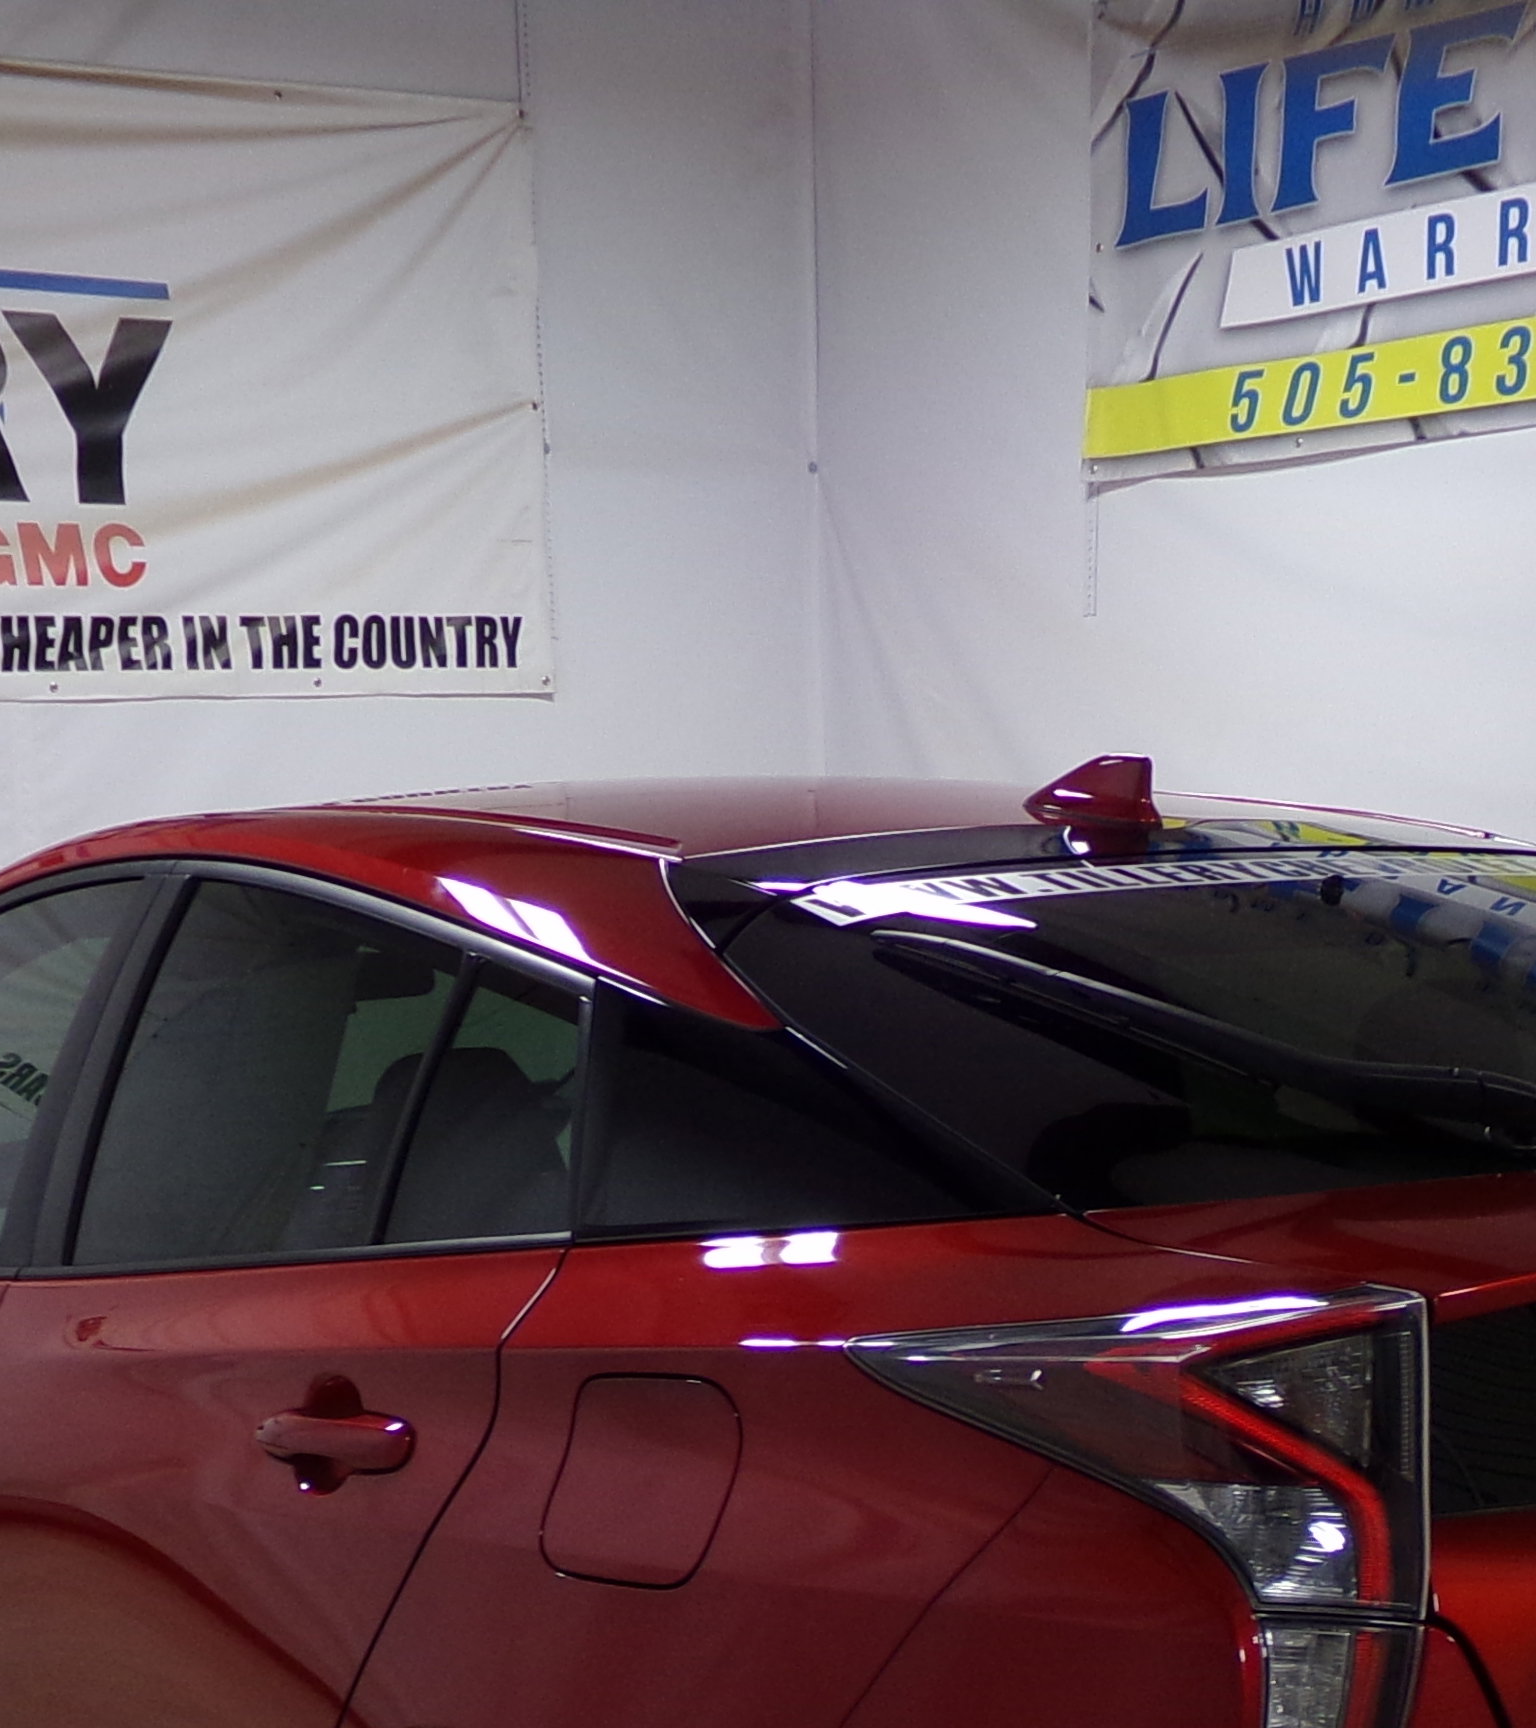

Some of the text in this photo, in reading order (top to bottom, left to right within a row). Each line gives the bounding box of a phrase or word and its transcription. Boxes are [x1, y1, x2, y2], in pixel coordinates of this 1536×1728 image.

[182, 615, 232, 670] IN
[240, 615, 321, 670] THE
[334, 614, 522, 669] COUNTRY
